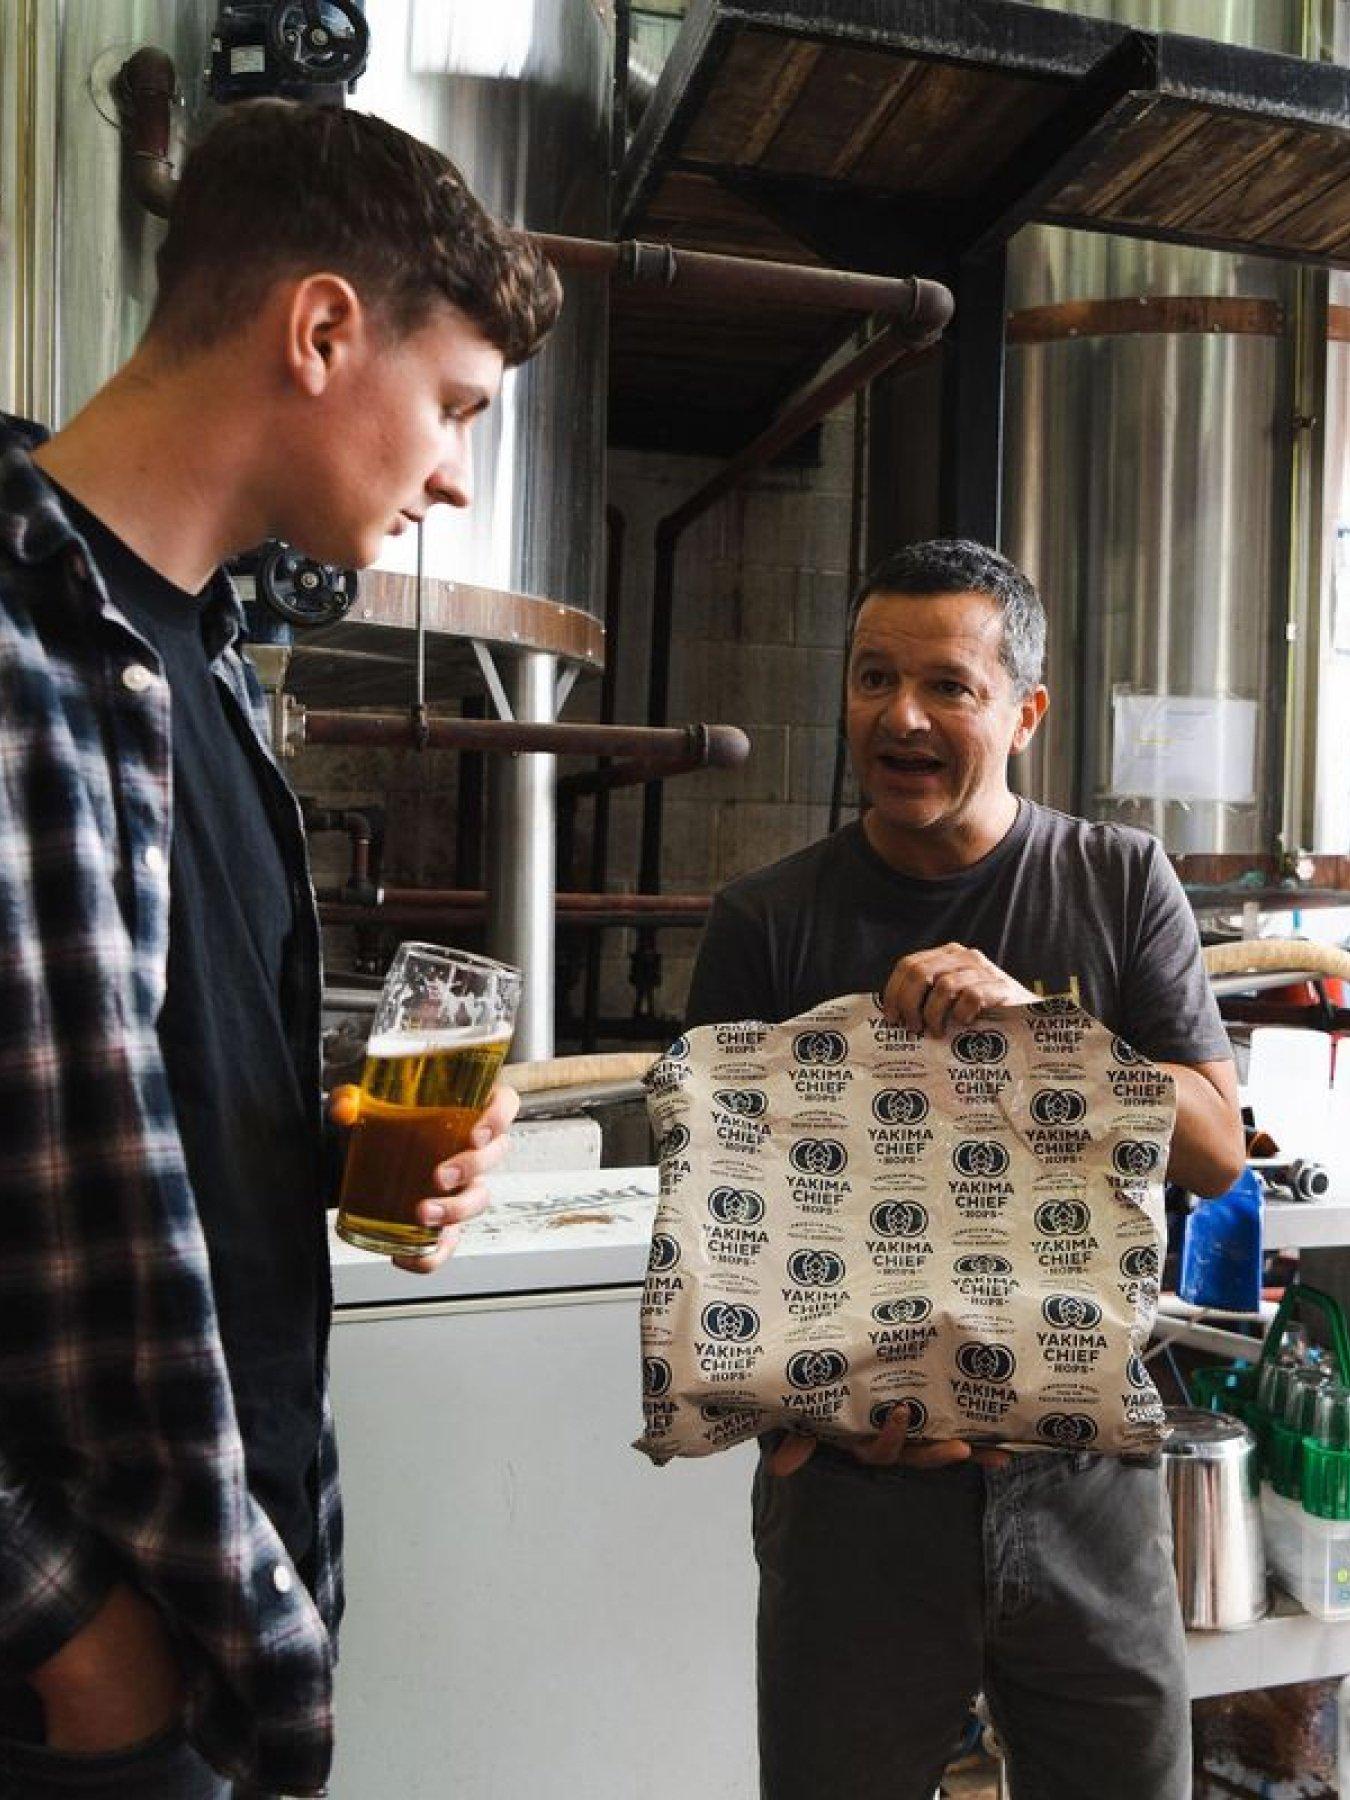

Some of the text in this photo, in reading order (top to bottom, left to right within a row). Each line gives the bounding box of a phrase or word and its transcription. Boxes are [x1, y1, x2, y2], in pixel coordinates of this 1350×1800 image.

[1026, 1018, 1093, 1029] YAKIMA
[716, 1032, 767, 1045] CHIEF
[1034, 1030, 1084, 1043] CHIEF
[789, 1068, 853, 1080] YAKIMA
[948, 1068, 1012, 1081] YAKIMA
[1106, 1071, 1174, 1084] YAKIMA
[796, 1082, 847, 1092] CHIEF
[955, 1082, 1005, 1097] CHIEF
[1113, 1085, 1167, 1097] CHIEF
[868, 1129, 934, 1141] YAKIMA
[1025, 1129, 1094, 1142] YAKIMA
[874, 1143, 926, 1154] CHIEF
[1034, 1143, 1086, 1155] CHIEF
[786, 1177, 851, 1193] YAKIMA
[949, 1181, 1014, 1195] YAKIMA
[793, 1190, 843, 1205] CHIEF
[955, 1197, 1008, 1209] CHIEF
[703, 1224, 769, 1243] YAKIMA
[707, 1240, 761, 1257] CHIEF
[866, 1241, 934, 1254] YAKIMA
[1030, 1237, 1099, 1253] YAKIMA
[872, 1255, 927, 1267] CHIEF
[1039, 1253, 1093, 1266] CHIEF
[645, 1278, 683, 1290] IMA
[781, 1289, 850, 1301] YAKIMA
[789, 1302, 841, 1315] CHIEF
[868, 1326, 938, 1345] YAKIMA
[1036, 1332, 1108, 1348] YAKIMA
[694, 1342, 764, 1357] YAKIMA
[1043, 1349, 1100, 1362] CHIEF
[701, 1358, 756, 1371] CHIEF
[781, 1386, 850, 1408] YAKIMA
[951, 1379, 1018, 1404] YAKIMA
[957, 1395, 1010, 1414] CHIEF
